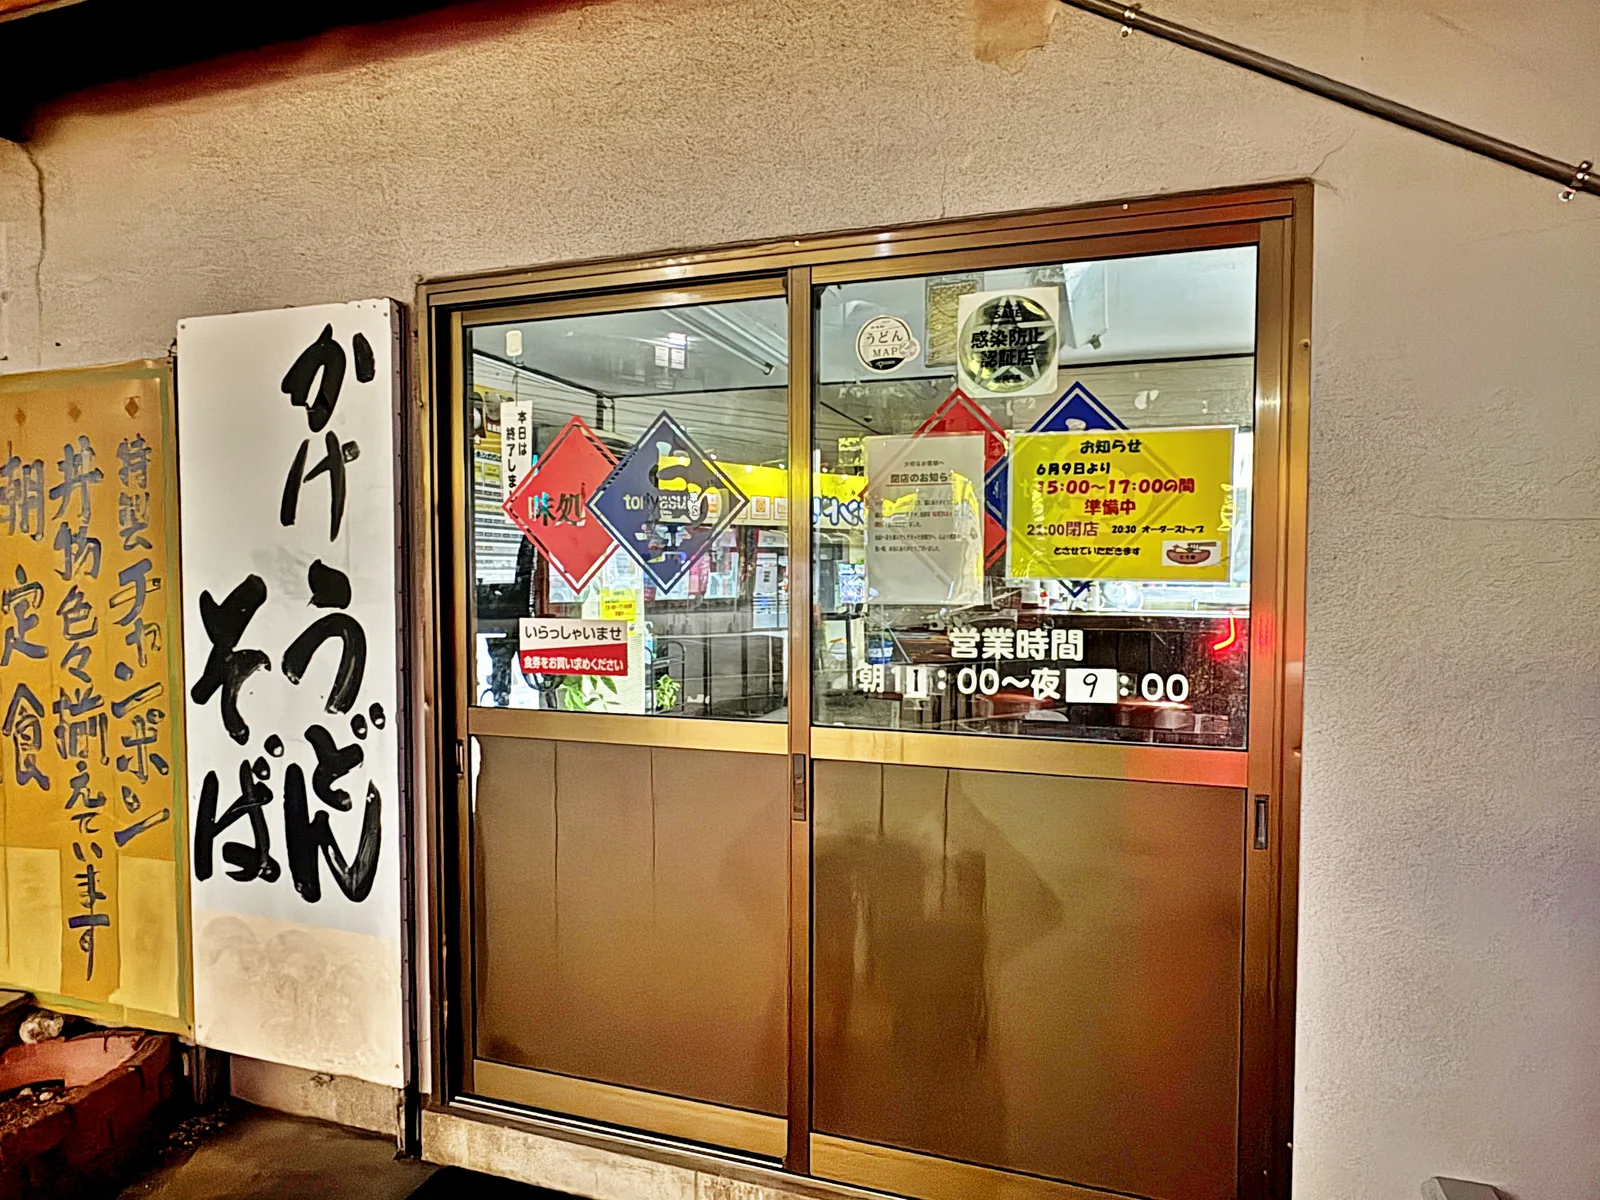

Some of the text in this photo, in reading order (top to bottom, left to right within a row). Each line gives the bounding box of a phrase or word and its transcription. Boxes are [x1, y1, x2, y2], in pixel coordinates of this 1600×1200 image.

[866, 330, 903, 345] うどん
[971, 327, 1046, 348] 感染防止
[873, 347, 898, 357] MAP
[517, 410, 527, 456] 本日は
[1080, 439, 1142, 454] お知らせ
[1036, 462, 1110, 475] 6月9日より
[890, 472, 957, 484] 閉店のお知ら
[528, 491, 587, 527] 味処
[1084, 499, 1136, 515] 準備中
[1027, 521, 1205, 536] 21:00閉店 20:30 オーダーストップ
[1054, 546, 1141, 556] とさせていただきます
[281, 323, 386, 903] かけうどん
[525, 625, 622, 641] いらっしゃいませ
[950, 628, 1084, 661] 営業時間
[523, 655, 624, 671] 食券をお買い求めください
[191, 573, 284, 882] そば
